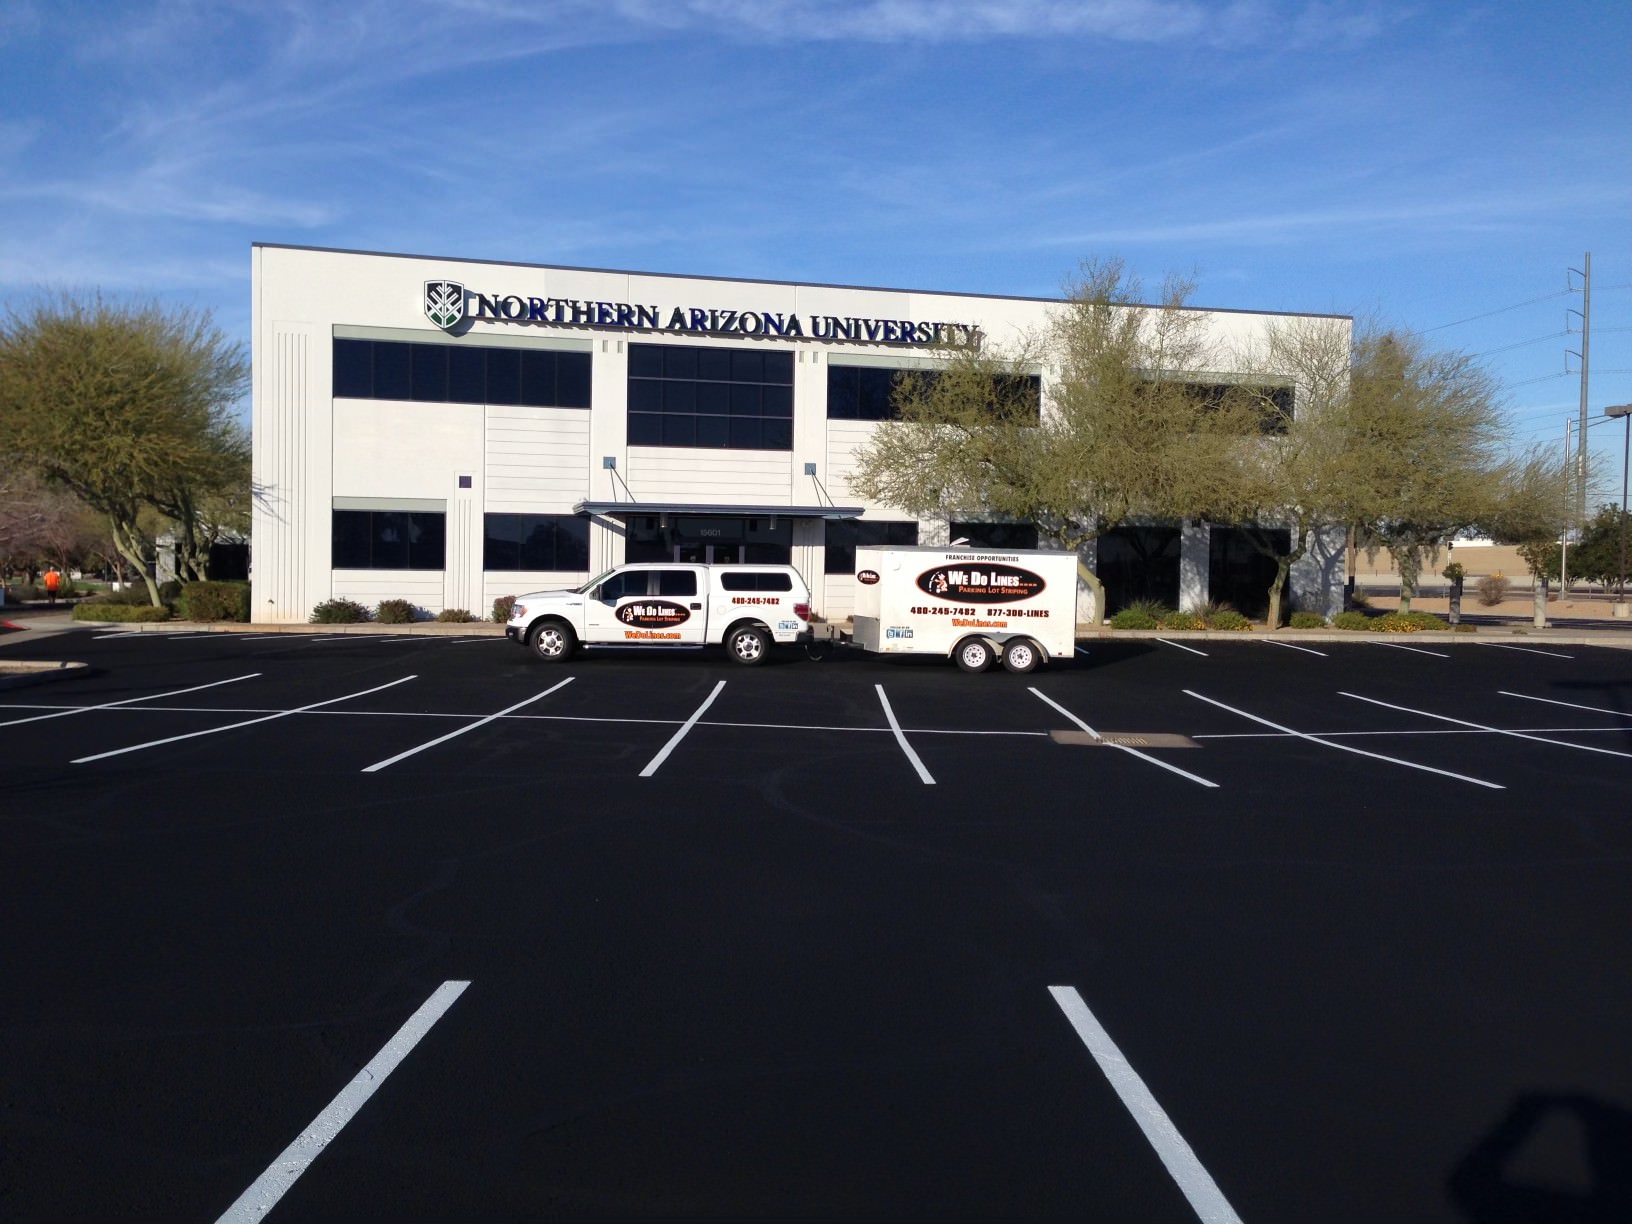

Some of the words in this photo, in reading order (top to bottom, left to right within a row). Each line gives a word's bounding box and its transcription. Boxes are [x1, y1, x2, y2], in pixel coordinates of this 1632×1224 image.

[476, 293, 659, 327] NORTHERN
[666, 306, 804, 337] ARIZONA
[810, 315, 980, 344] UNIVERSITY
[947, 570, 968, 585] WE
[971, 571, 988, 586] DO
[991, 572, 1020, 587] LINES
[958, 585, 987, 594] PARKING
[988, 586, 999, 594] LOT
[1001, 587, 1028, 595] STRIPING
[731, 597, 780, 605] 480-245-7482
[910, 606, 976, 616] 480-245-7482
